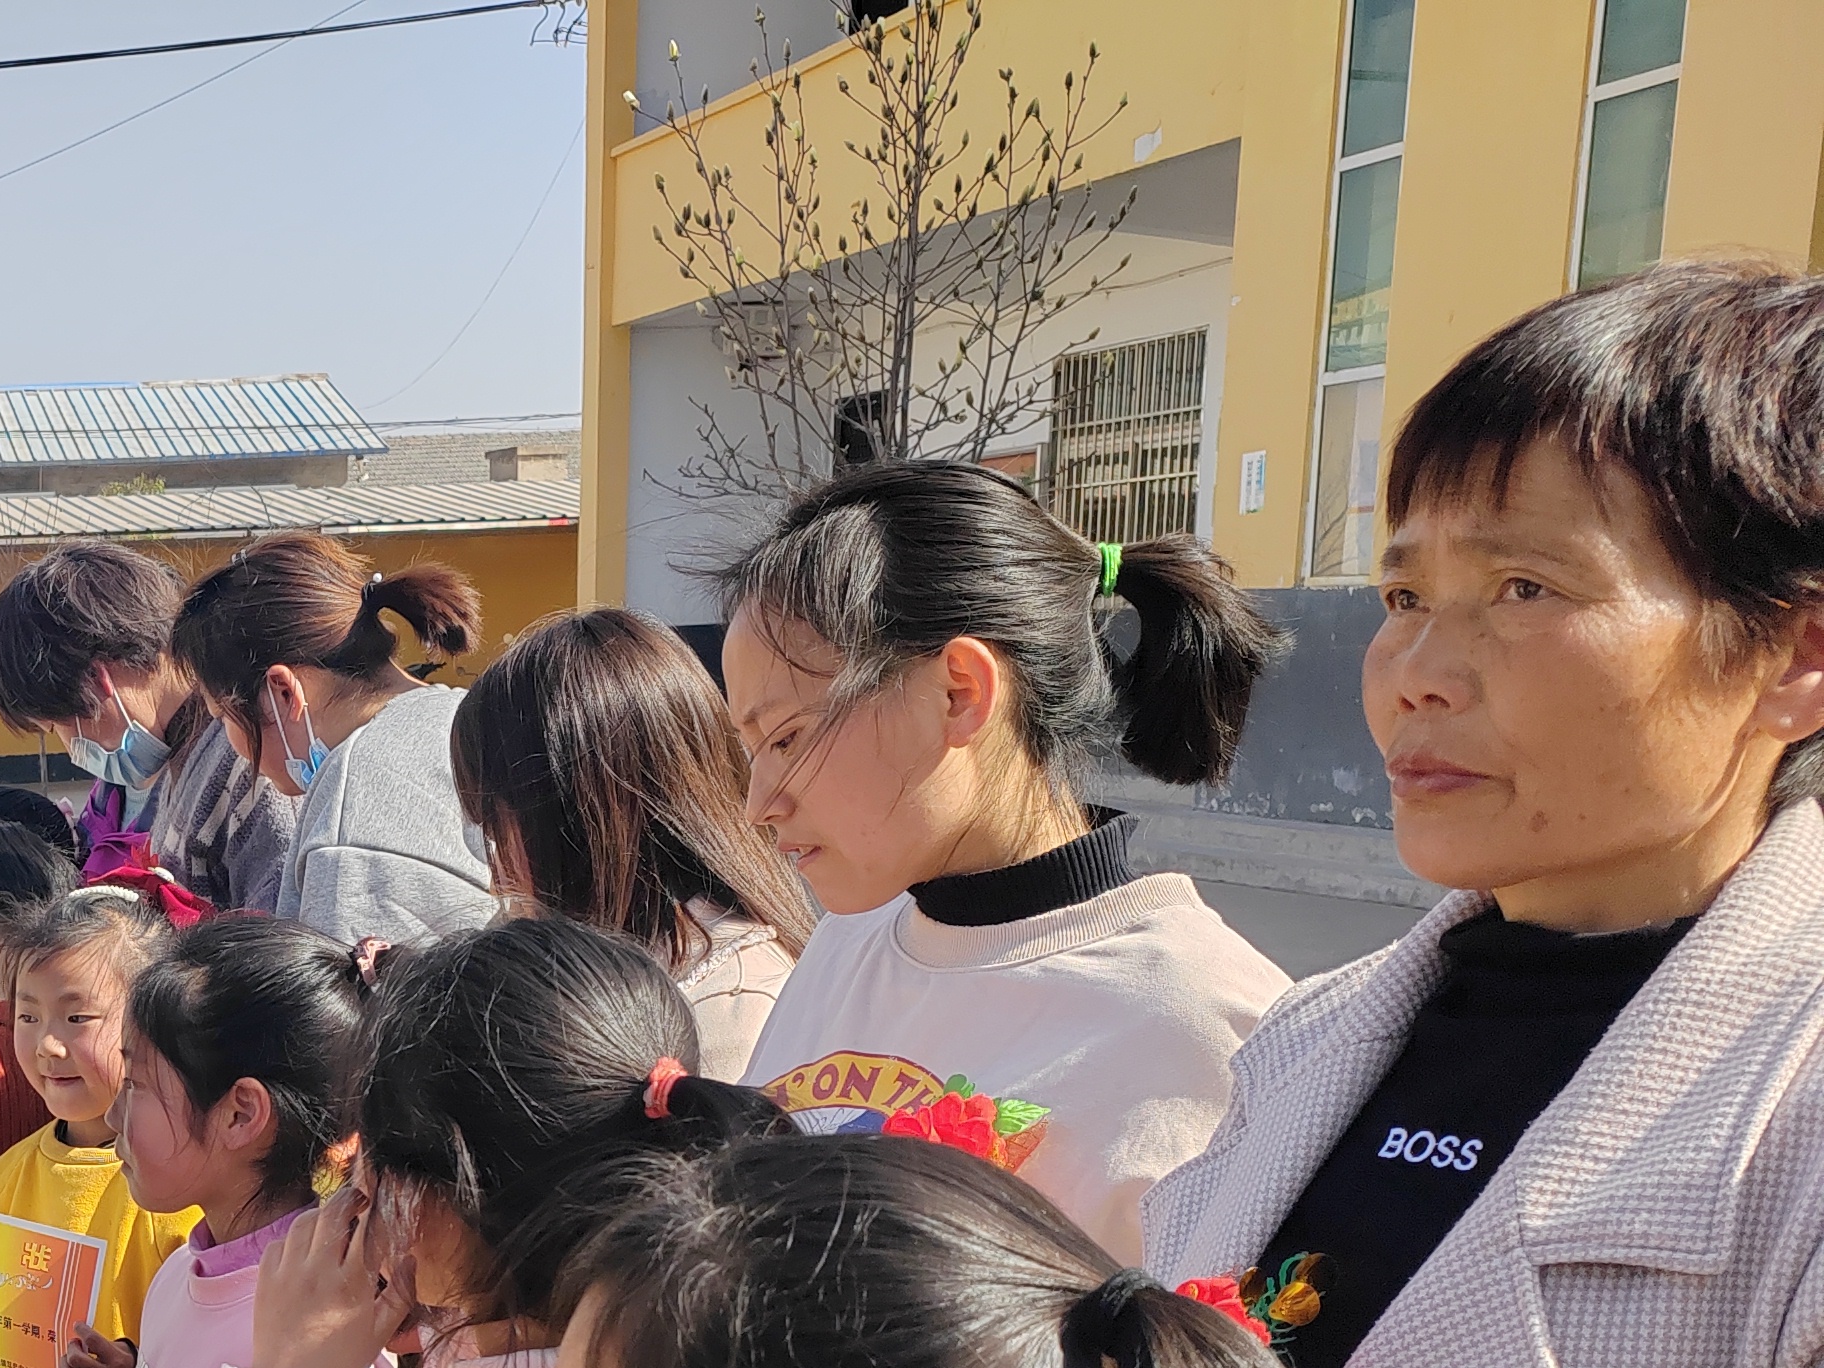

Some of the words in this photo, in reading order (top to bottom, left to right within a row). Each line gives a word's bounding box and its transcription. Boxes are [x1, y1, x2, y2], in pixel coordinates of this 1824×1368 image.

[812, 1061, 883, 1102] ON
[1377, 1127, 1483, 1171] BOSS
[21, 1241, 52, 1273] 状
